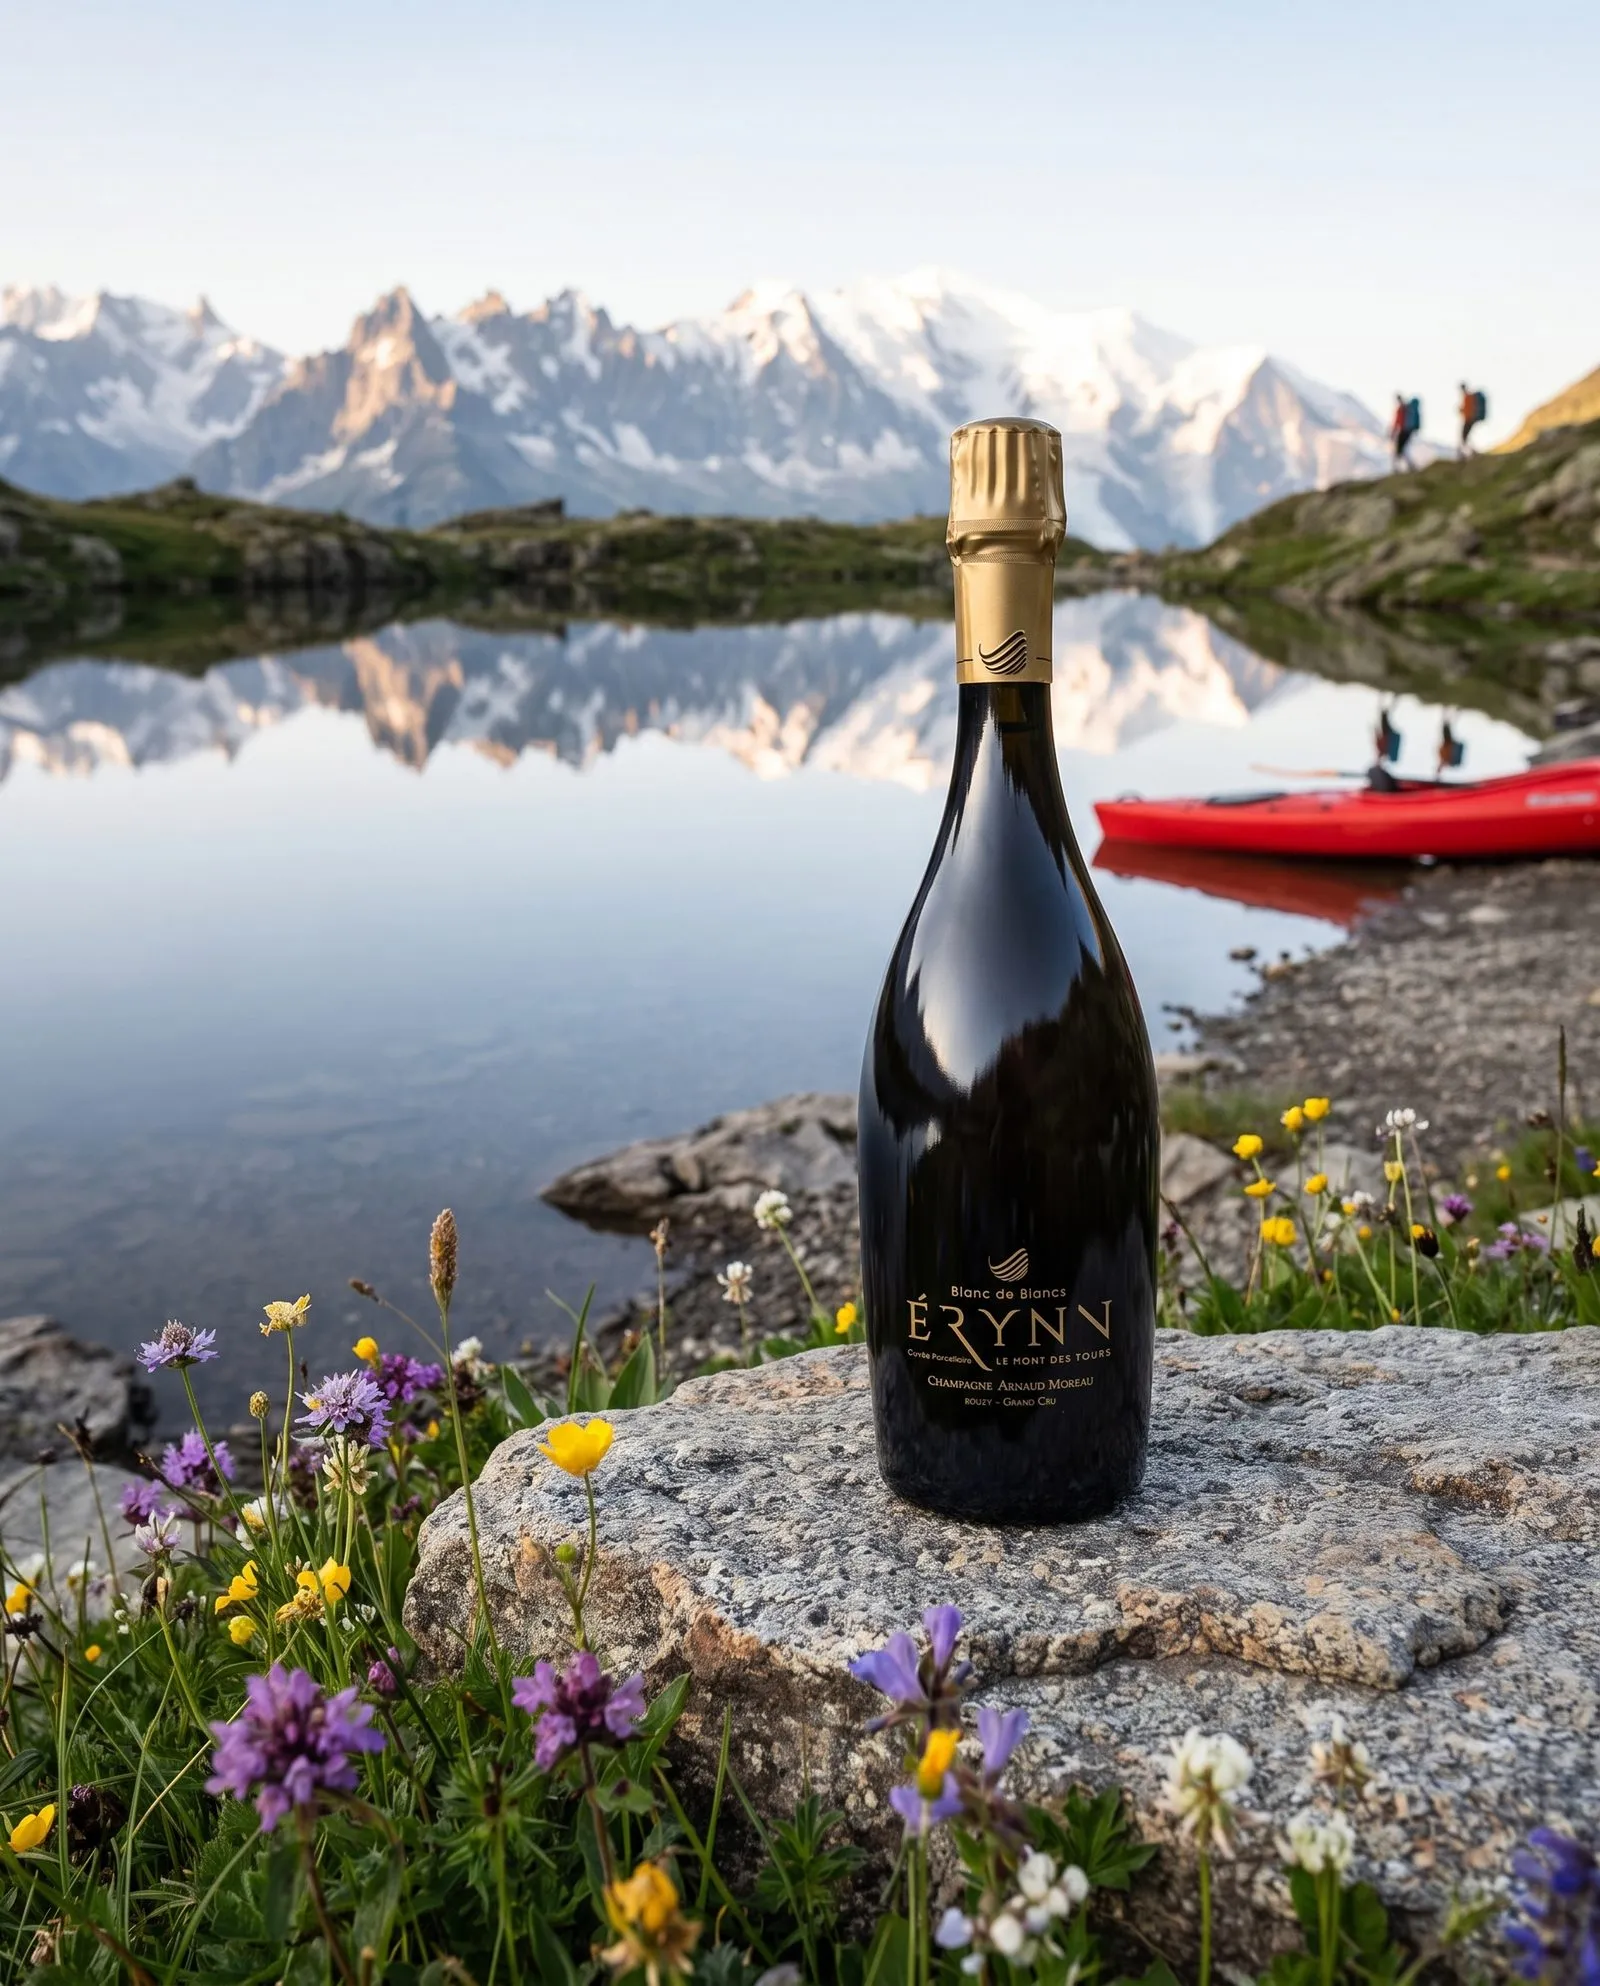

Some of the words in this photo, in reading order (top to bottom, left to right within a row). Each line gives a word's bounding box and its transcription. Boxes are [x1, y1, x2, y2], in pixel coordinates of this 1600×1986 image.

[951, 1285, 990, 1300] Blanc
[995, 1288, 1014, 1300] de
[1020, 1287, 1067, 1300] Blancs
[906, 1292, 1113, 1372] ÉRYNN
[996, 1356, 1009, 1366] LE
[1013, 1356, 1046, 1366] MONT
[1050, 1354, 1071, 1365] DES
[1075, 1347, 1112, 1362] TOURS
